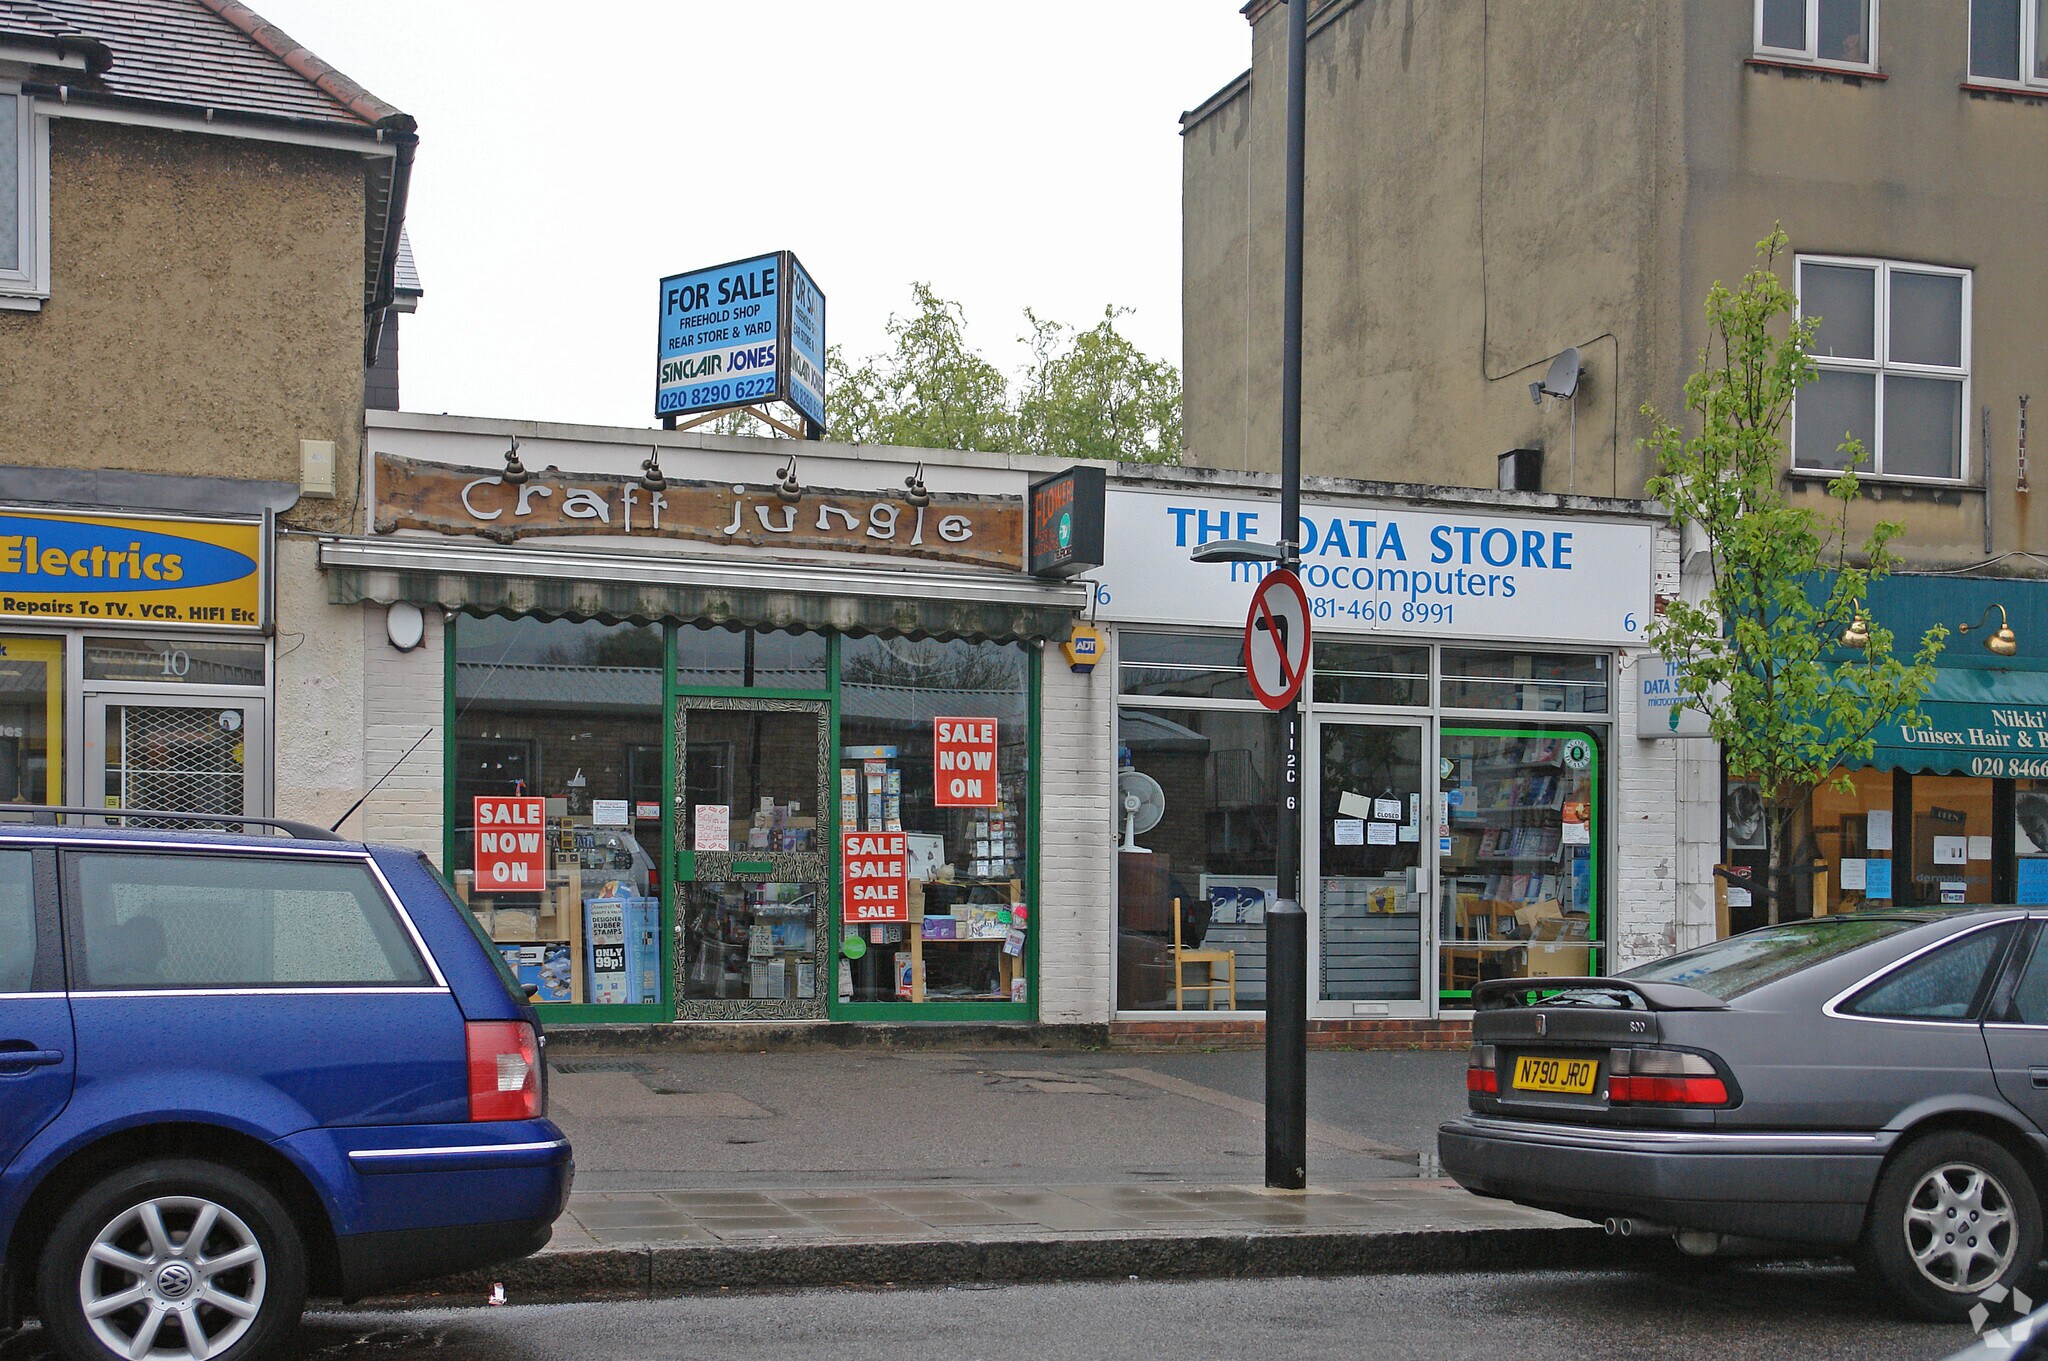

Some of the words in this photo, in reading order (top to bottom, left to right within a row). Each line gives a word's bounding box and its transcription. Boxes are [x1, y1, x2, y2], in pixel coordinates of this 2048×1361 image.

[668, 283, 709, 315] FOR
[718, 268, 774, 305] SALE
[680, 310, 729, 330] FREEHOLD
[733, 304, 760, 320] SHOP
[669, 333, 694, 350] REAR
[697, 329, 728, 344] STORE
[732, 326, 740, 337] &
[744, 321, 771, 336] YARD
[661, 354, 722, 383] SINCLAIR
[726, 345, 775, 373] JONES
[661, 390, 687, 410] 020
[691, 384, 730, 405] 8290
[735, 377, 775, 398] 6222
[461, 476, 668, 533] Craft
[723, 485, 973, 546] jungle
[0, 535, 184, 581] Electrics
[1430, 525, 1573, 570] STORE
[1097, 584, 1111, 605] 6
[3, 597, 73, 614] Repairs
[80, 601, 99, 615] To
[189, 606, 224, 620] HIFI
[231, 608, 255, 622] Etc
[1402, 602, 1453, 624] 8991
[1624, 612, 1637, 632] 6
[1075, 640, 1095, 652] ADT
[160, 650, 189, 676] 10
[1644, 679, 1670, 694] DATA
[939, 723, 992, 743] SALE
[1900, 725, 1965, 744] Unisex
[1967, 728, 2011, 747] Hair
[2018, 730, 2034, 748] &
[940, 751, 992, 770] NOW
[1971, 757, 2004, 776] 020
[950, 778, 982, 798] ON
[480, 803, 540, 824] SALE
[481, 832, 540, 853] NOW
[847, 837, 904, 855] SALE
[493, 862, 528, 882] ON
[849, 861, 902, 878] SALE
[853, 885, 899, 900] SALE
[858, 905, 896, 918] SALE
[595, 948, 623, 957] ONLY
[596, 956, 623, 969] 99p!
[1520, 1060, 1559, 1084] N790
[1561, 1063, 1590, 1086] JRO
